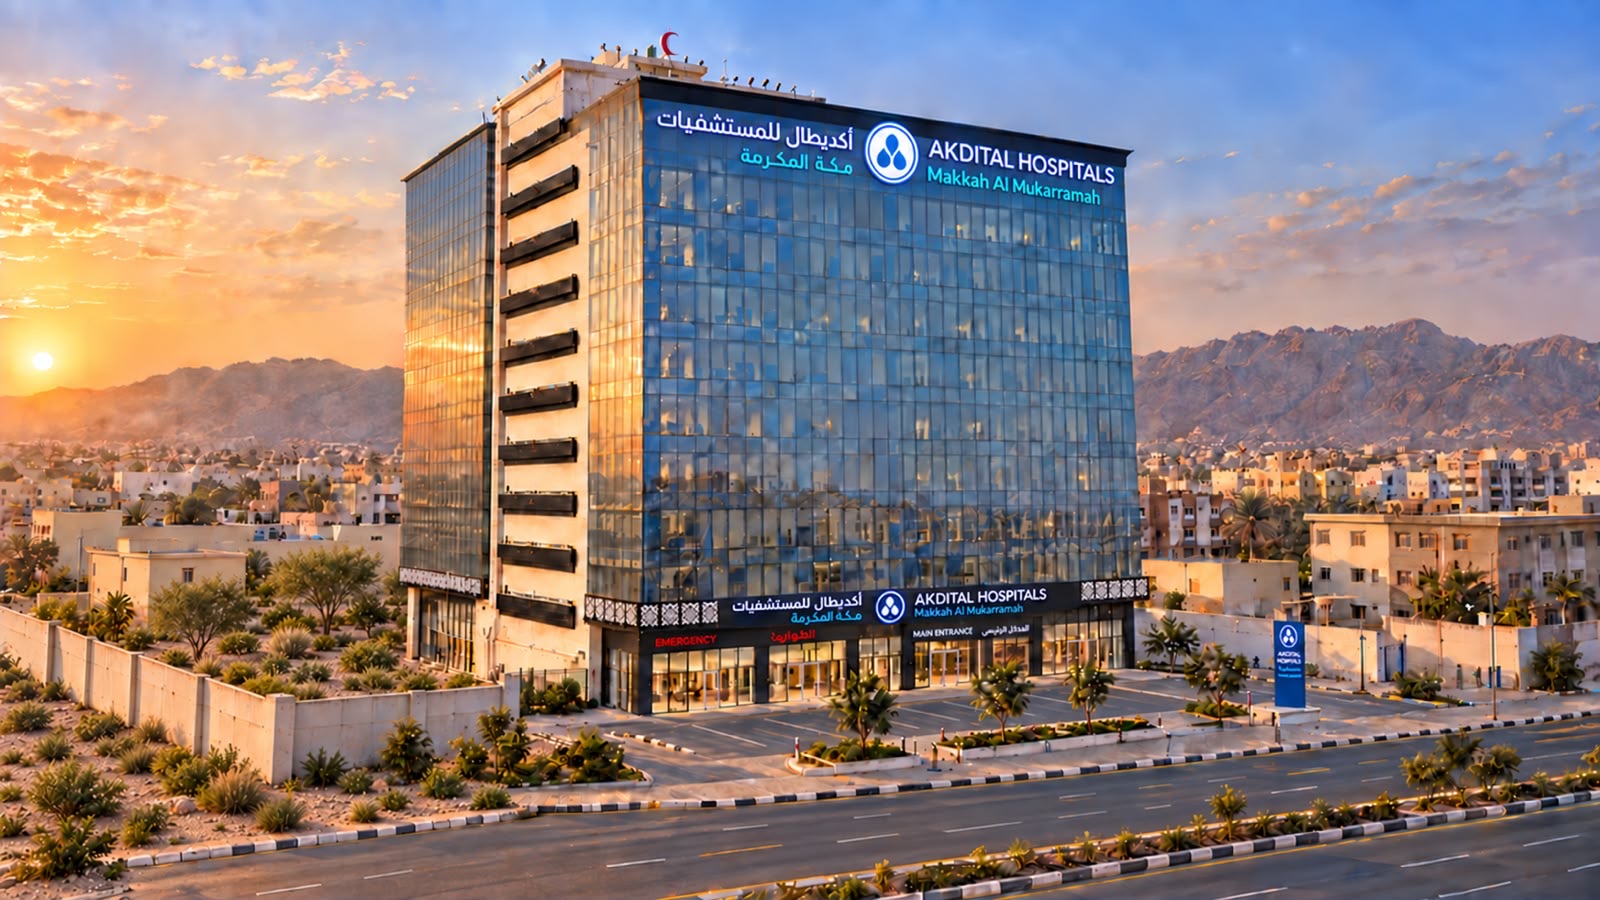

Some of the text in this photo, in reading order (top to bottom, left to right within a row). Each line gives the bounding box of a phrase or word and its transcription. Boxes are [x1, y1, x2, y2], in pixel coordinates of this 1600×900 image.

[657, 110, 854, 151] أكديطال للمستشفيات
[740, 147, 853, 176] مكة المكرمة
[928, 139, 1116, 185] AKDITAL HOSPITALS
[928, 166, 1101, 206] Makkah Al Mukarramah
[732, 592, 862, 615] أكديطال للمستشفيات
[914, 588, 1047, 606] AKDITAL HOSPITALS
[790, 612, 862, 626] مكة المكرمة
[914, 604, 1024, 618] Makkah Al Mukarramah
[655, 634, 717, 648] EMERGENCY
[912, 626, 973, 638] MAIN ENTRANCE
